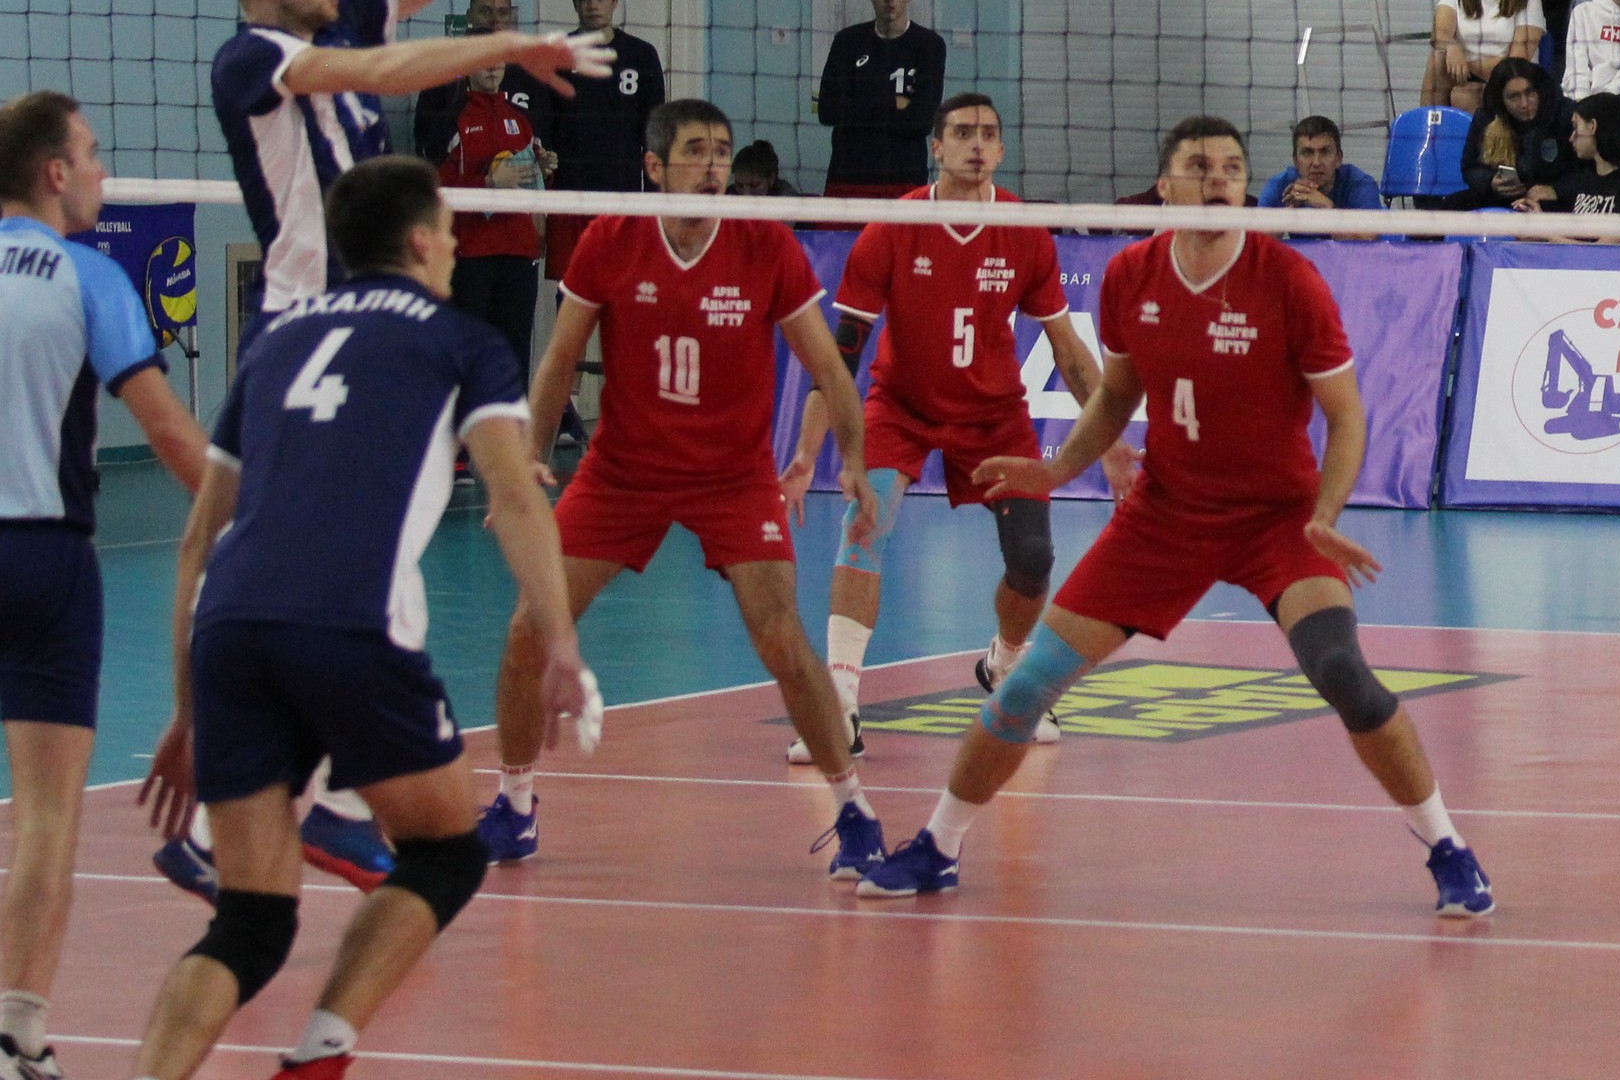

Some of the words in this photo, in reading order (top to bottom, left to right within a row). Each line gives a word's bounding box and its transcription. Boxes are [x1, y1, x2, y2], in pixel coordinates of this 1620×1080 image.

[619, 69, 638, 95] 8
[96, 222, 132, 232] VOLLEYBALL
[1060, 272, 1091, 286] ВАЯ
[654, 334, 700, 397] 10
[952, 307, 975, 368] 5
[283, 326, 355, 422] 4
[1172, 377, 1200, 441] 4
